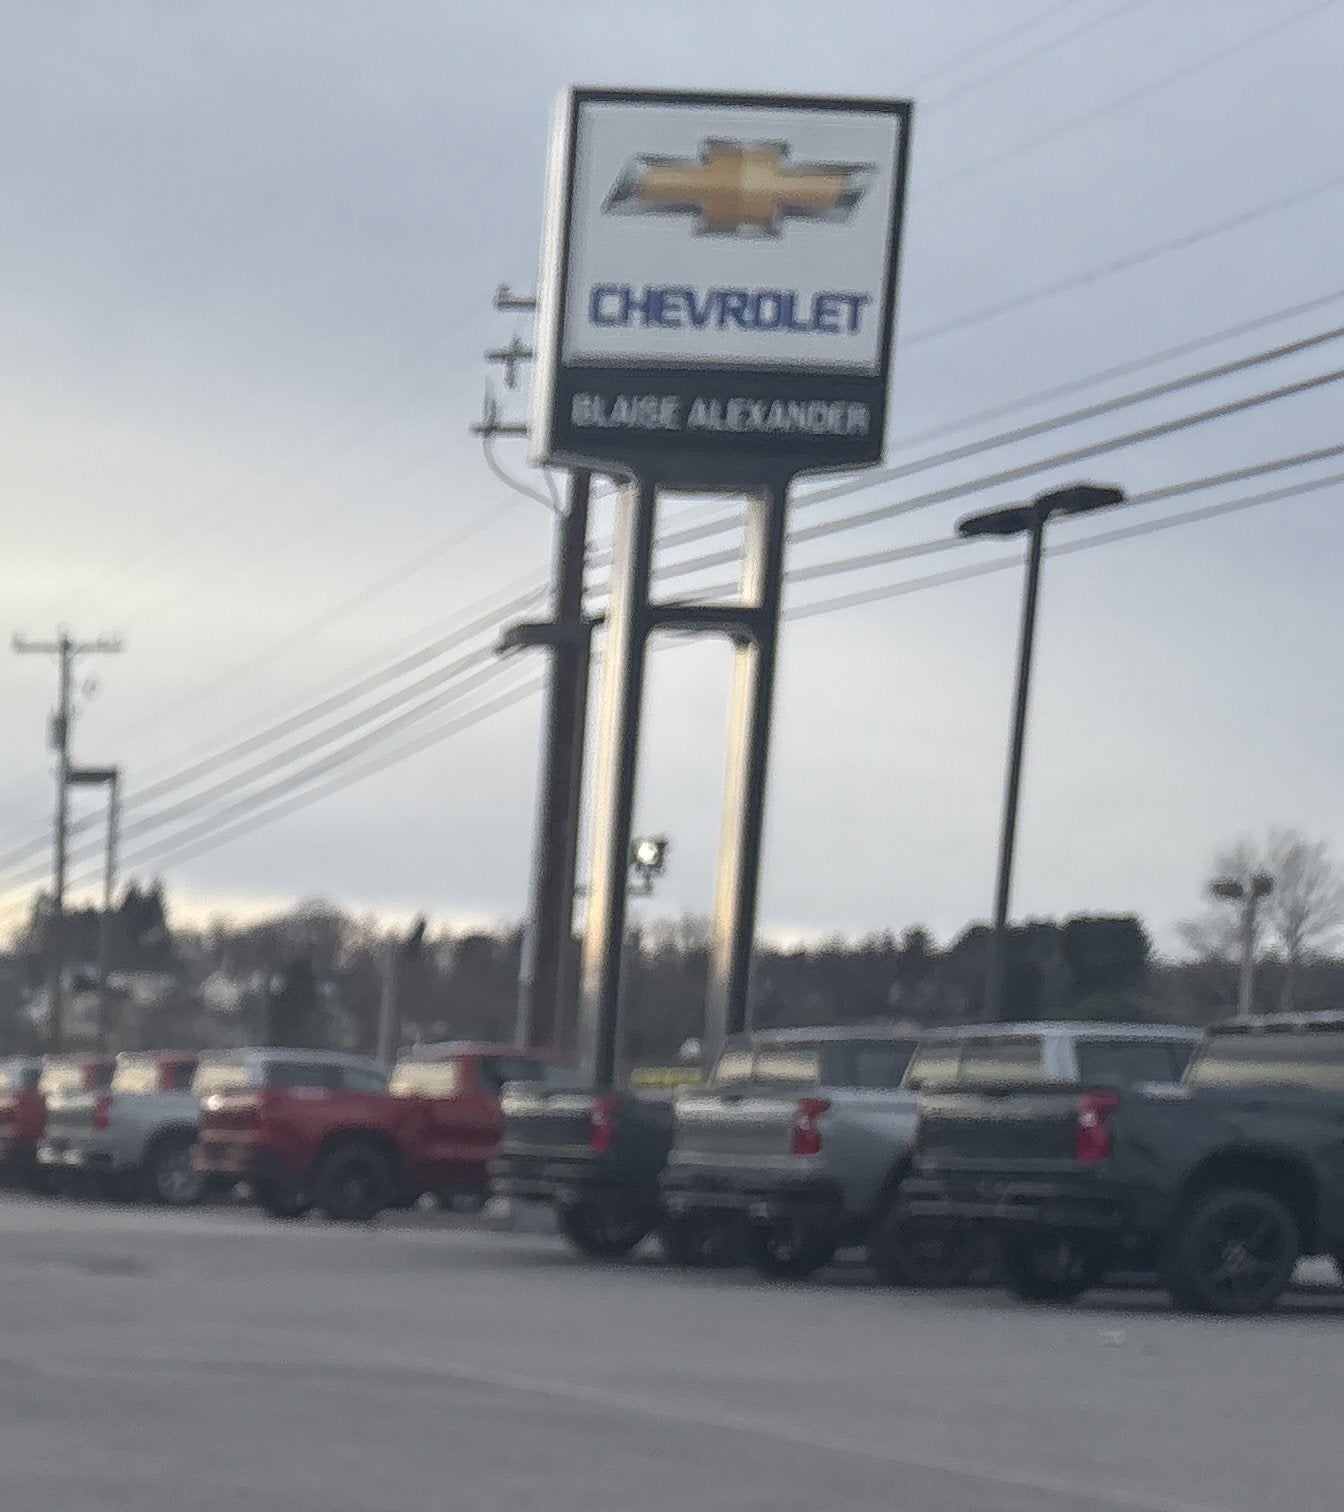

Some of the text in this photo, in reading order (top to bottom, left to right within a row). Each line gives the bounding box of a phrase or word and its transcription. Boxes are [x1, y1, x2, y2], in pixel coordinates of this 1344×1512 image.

[588, 283, 870, 335] CHEVROLET
[571, 392, 870, 435] BLAISE ALEXANDER
